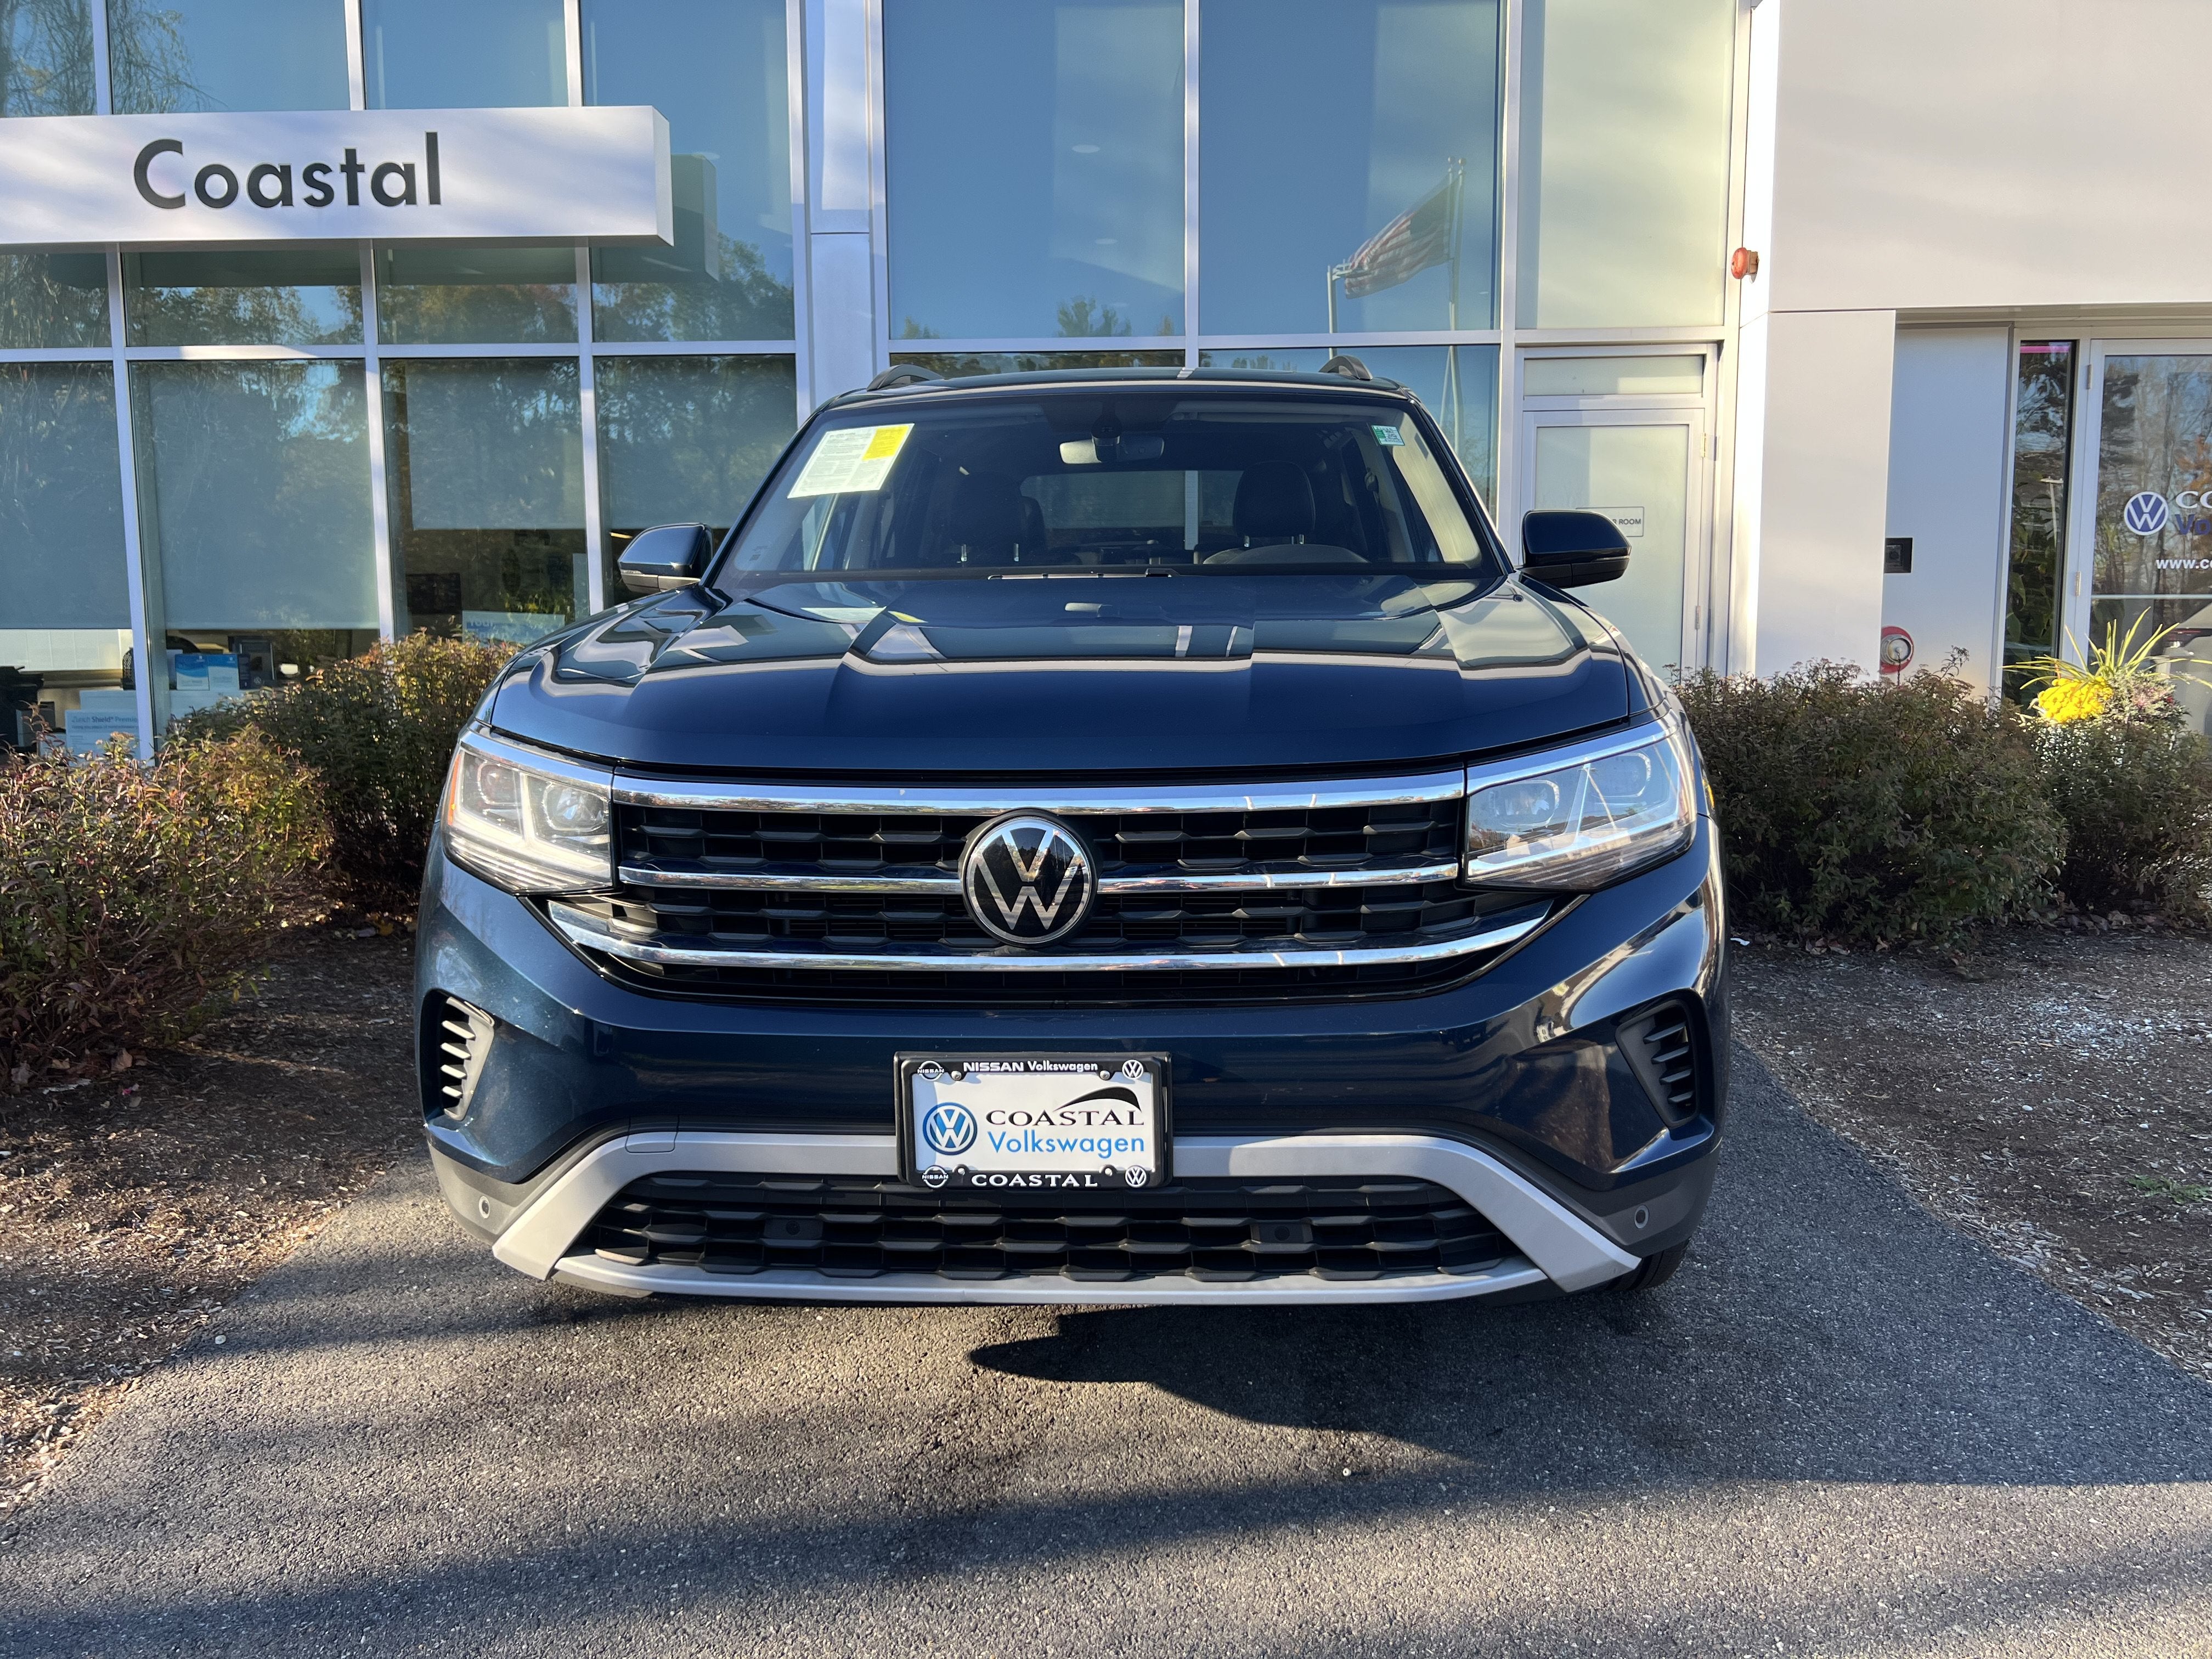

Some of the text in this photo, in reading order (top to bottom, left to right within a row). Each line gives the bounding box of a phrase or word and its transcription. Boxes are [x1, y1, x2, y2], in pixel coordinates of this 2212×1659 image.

[134, 131, 442, 209] Coastal
[2156, 558, 2212, 569] www.c
[963, 1059, 1098, 1073] NISSAN Volkswagen
[985, 1108, 1144, 1127] COASTAL
[987, 1129, 1144, 1159] Volkswagen
[971, 1173, 1098, 1188] COASTAL
